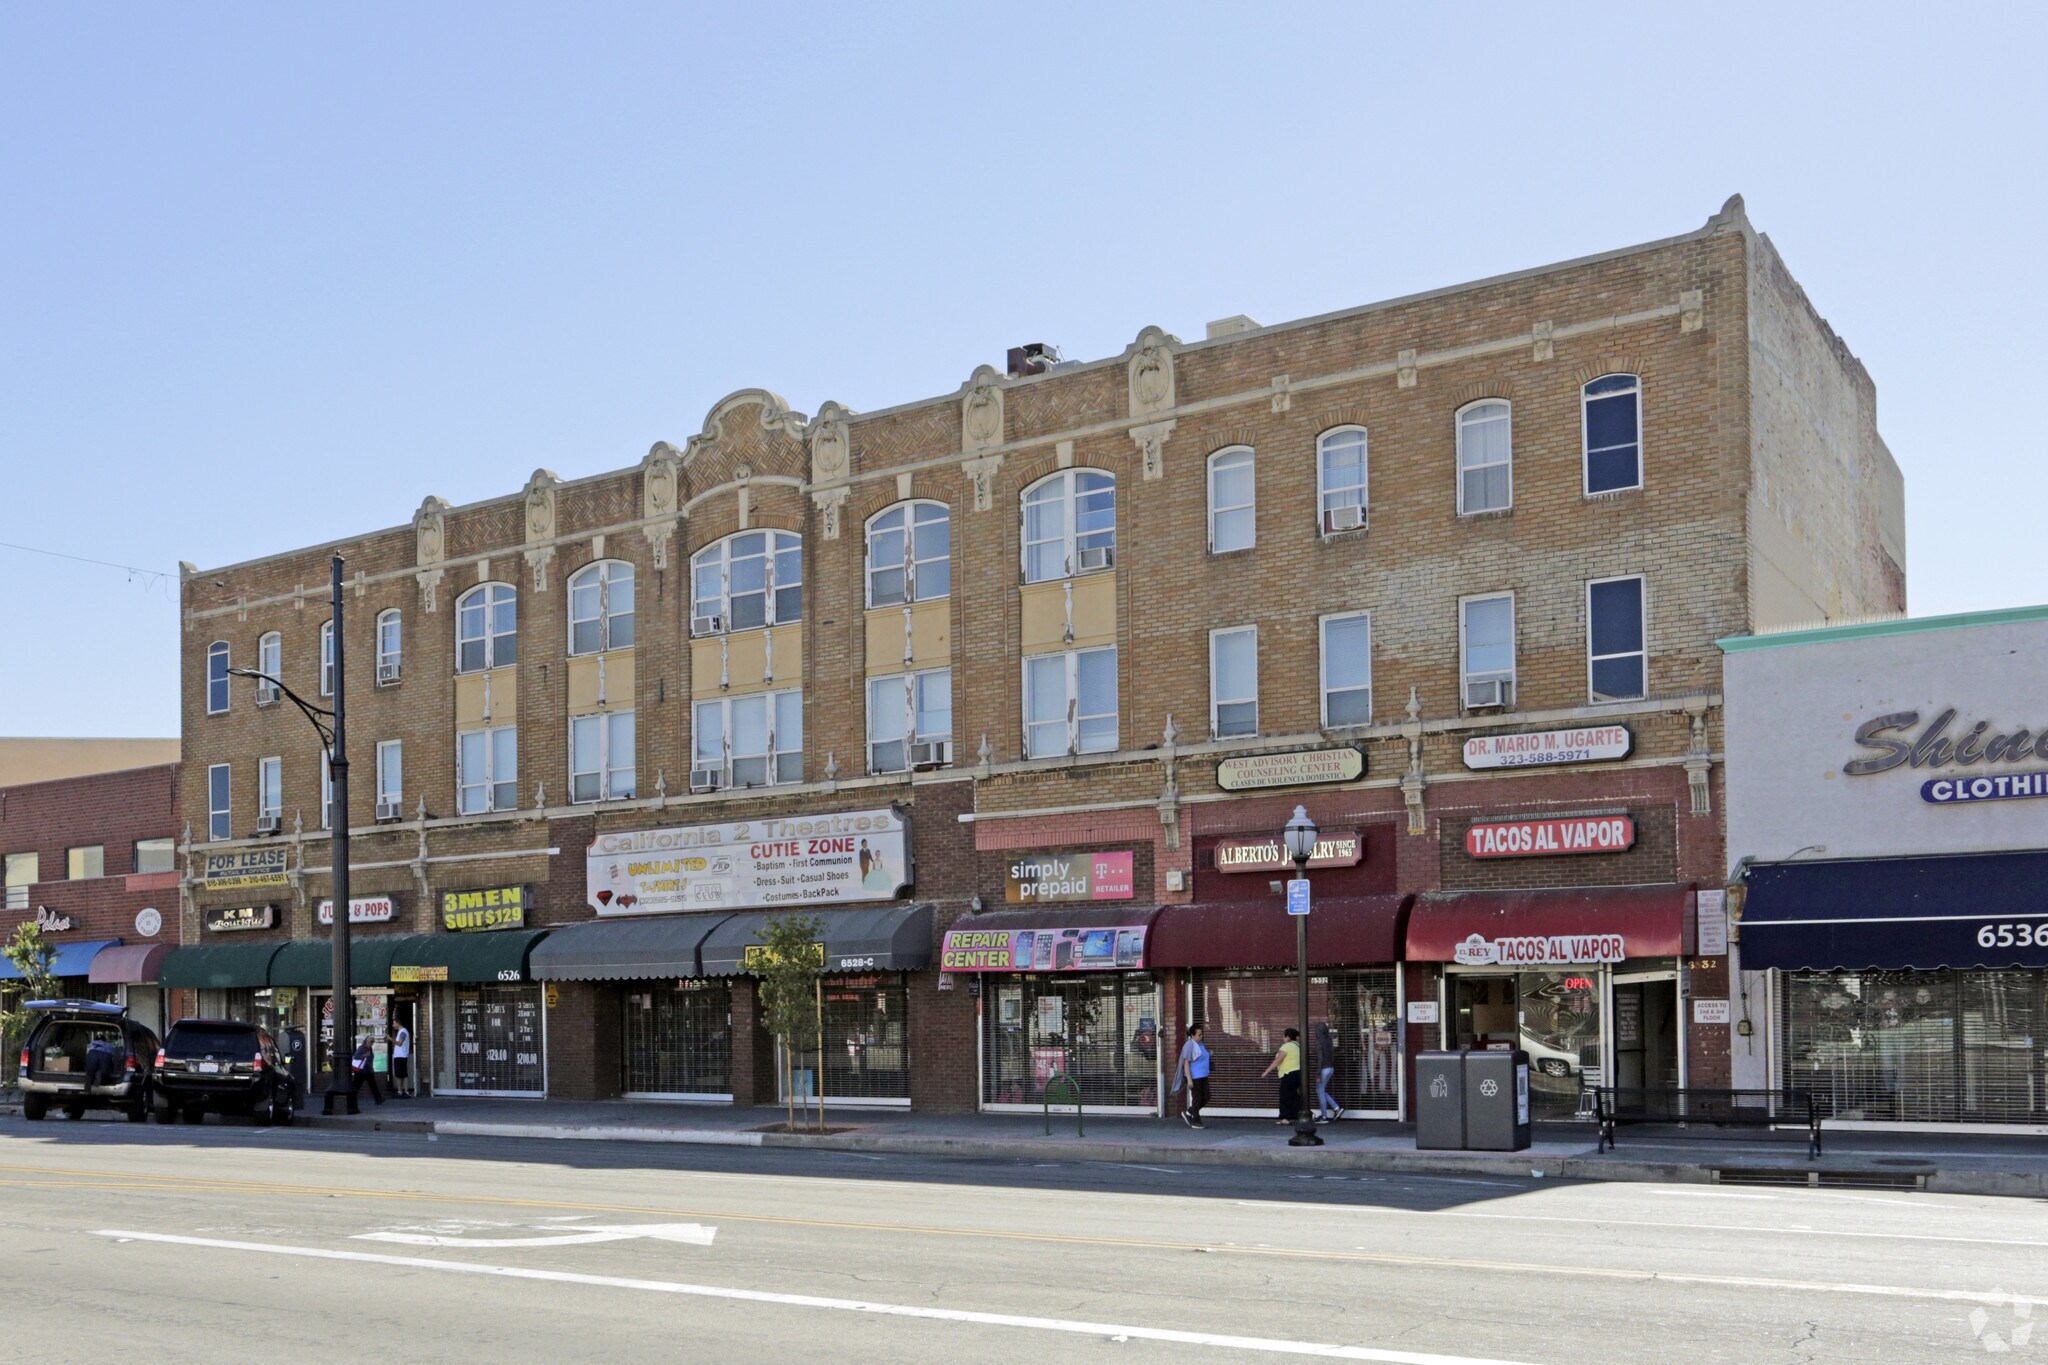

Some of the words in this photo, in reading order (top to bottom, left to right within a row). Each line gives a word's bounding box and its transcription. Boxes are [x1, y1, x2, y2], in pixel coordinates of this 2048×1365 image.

[1468, 739, 1491, 756] DR.
[1495, 735, 1540, 753] MARIO
[1544, 733, 1559, 750] M.
[1564, 728, 1623, 748] UGARTE
[1224, 760, 1250, 770] WEST
[1251, 754, 1298, 769] ADVISORY
[1302, 750, 1355, 763] CHRISTIAN
[1500, 749, 1590, 766] 323-588-5971
[1236, 766, 1297, 780] COUNSELING
[1300, 761, 1341, 773] CENTER
[1230, 779, 1256, 788] CLASES
[1266, 775, 1306, 785] VIOLENCIA
[1305, 771, 1347, 782] DOMESTICA
[1931, 773, 2048, 800] CLOTHI
[600, 827, 721, 853] California
[733, 823, 750, 841] 2
[761, 815, 890, 838] Theatres
[1472, 825, 1533, 854] TACOS
[1535, 824, 1558, 850] AL
[1560, 820, 1625, 849] VAPOR
[751, 841, 800, 859] CUTIE
[808, 837, 855, 855] ZONE
[1220, 839, 1279, 865] ALBERTO'S
[1336, 839, 1356, 850] SINCE
[1338, 848, 1353, 858] 1965
[208, 855, 236, 869] FOR
[241, 849, 286, 867] LEASE
[628, 856, 708, 877] UNLIMITED
[756, 861, 785, 873] Baptism
[810, 856, 853, 867] Communion
[1011, 859, 1070, 881] simply
[640, 878, 688, 893] T-SHIRTS
[756, 877, 777, 887] Dress
[781, 875, 795, 885] Suit
[800, 872, 824, 883] Casual
[826, 871, 849, 880] Shoes
[765, 892, 799, 902] Costumes
[803, 887, 840, 899] BackPack
[1020, 876, 1087, 900] prepaid
[1095, 884, 1129, 893] RETAILER
[354, 903, 361, 917] &
[364, 902, 389, 917] POPS
[214, 916, 265, 928] Boutique
[949, 932, 1011, 949] REPAIR
[1468, 947, 1491, 957] REY
[1497, 940, 1545, 961] TACOS
[1549, 939, 1567, 960] AL
[1570, 938, 1622, 959] VAPOR
[841, 957, 874, 968] 6528-C
[943, 950, 1011, 968] CENTER
[497, 970, 520, 981] 6526
[1564, 977, 1593, 989] OPEN
